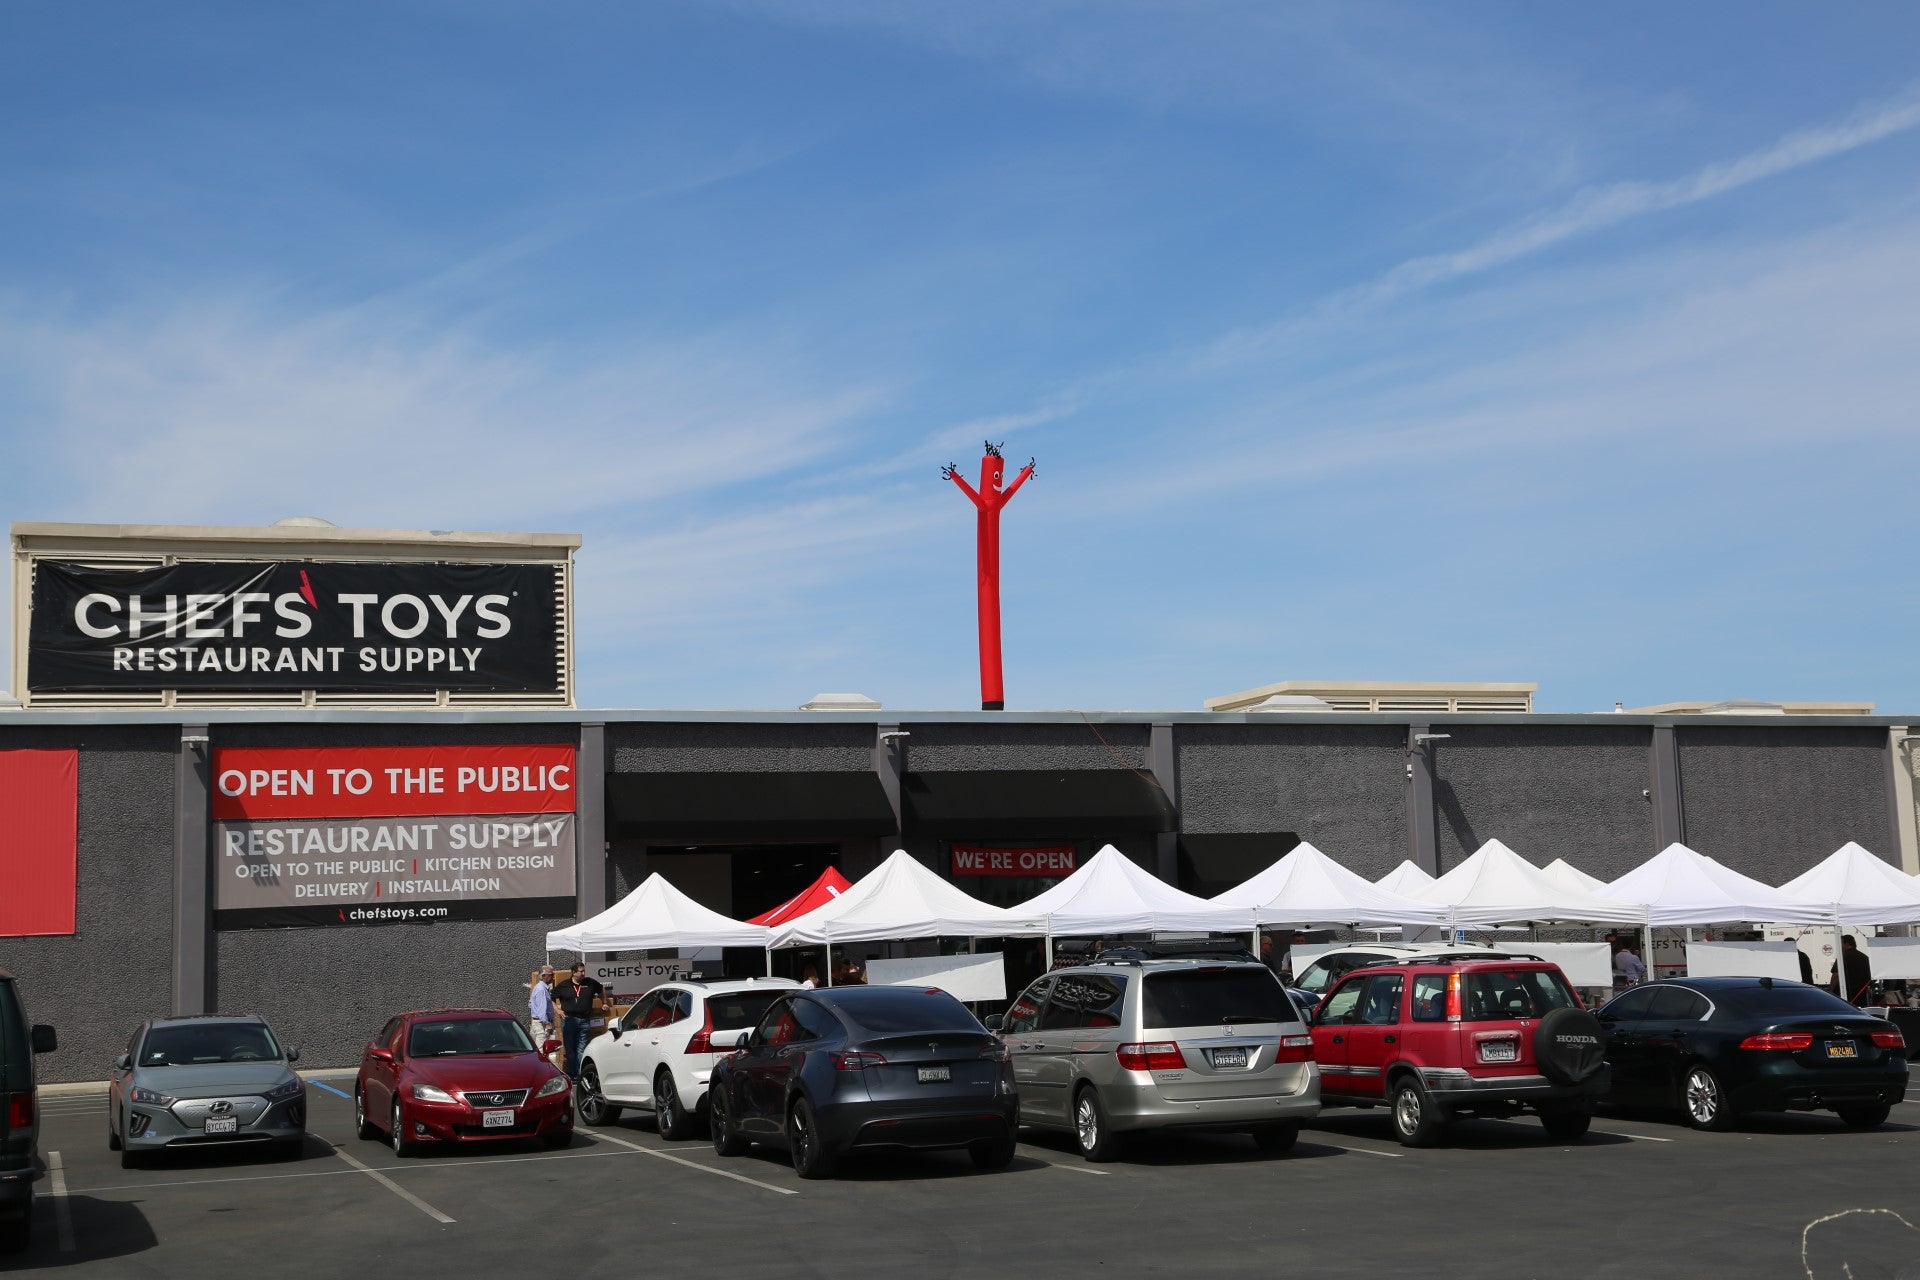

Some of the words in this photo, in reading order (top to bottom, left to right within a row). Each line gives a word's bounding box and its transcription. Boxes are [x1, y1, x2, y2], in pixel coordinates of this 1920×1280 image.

[113, 647, 345, 672] RESTAURANT
[359, 647, 483, 672] SUPPLY
[218, 769, 314, 797] OPEN
[326, 768, 373, 795] TO
[384, 767, 444, 794] THE
[457, 765, 570, 793] PUBLIC
[225, 824, 438, 857] RESTAURANT
[449, 821, 565, 850] SUPPLY
[235, 863, 281, 878] OPEN
[287, 863, 309, 876] TO
[314, 861, 344, 875] THE
[349, 859, 405, 874] PUBLIC
[425, 857, 492, 872] KITCHEN
[497, 855, 554, 870] DESIGN
[955, 851, 1013, 869] WE'RE
[1019, 852, 1073, 869] OPEN
[295, 881, 369, 897] DELIVERY
[388, 877, 500, 894] INSTALLATION
[349, 907, 448, 920] chefstoys.com
[1555, 1035, 1598, 1043] HONDA
